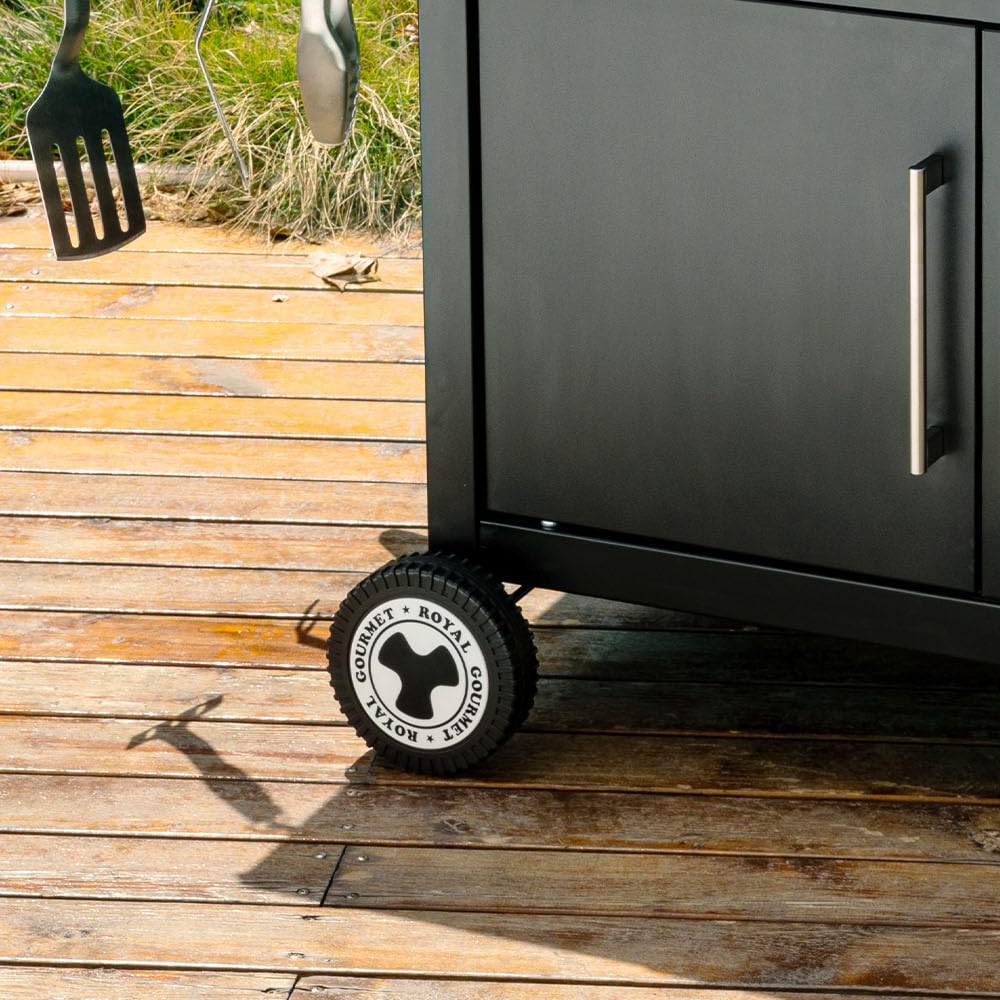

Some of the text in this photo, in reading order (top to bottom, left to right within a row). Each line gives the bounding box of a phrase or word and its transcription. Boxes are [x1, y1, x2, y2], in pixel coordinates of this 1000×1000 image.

[354, 607, 419, 743] ROYAL GOURMET
[418, 605, 483, 742] ROYAL GOURMET
